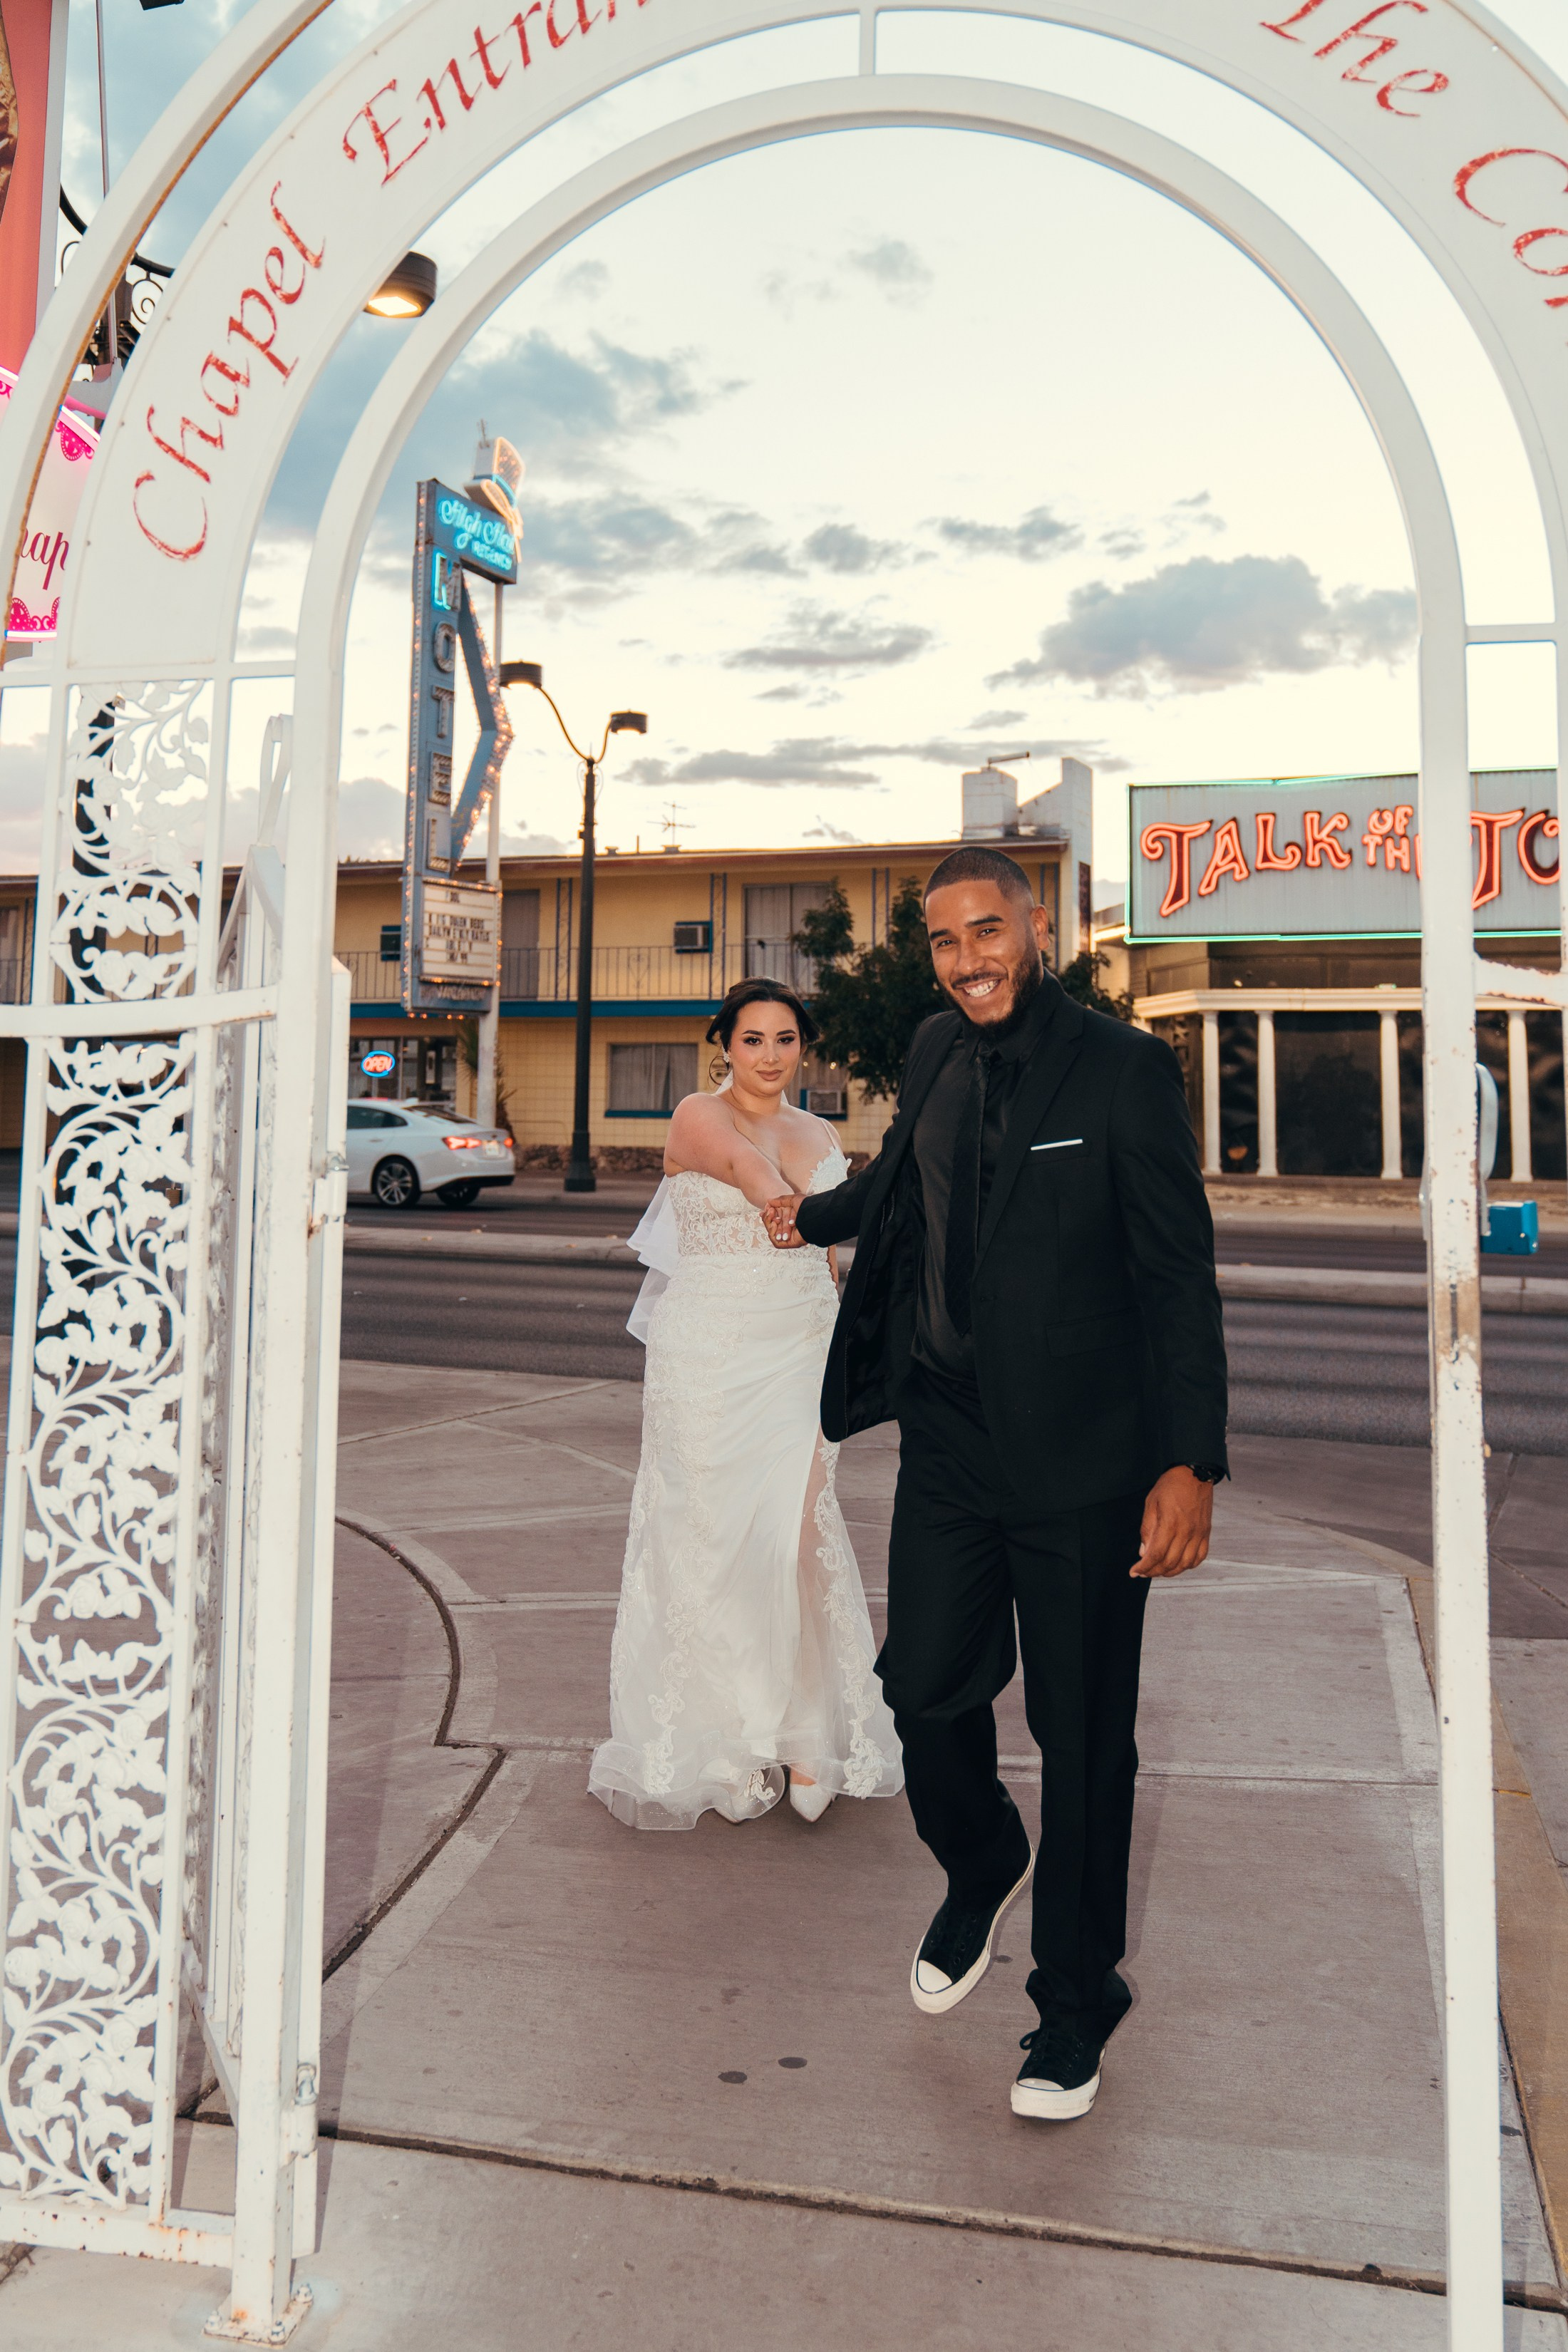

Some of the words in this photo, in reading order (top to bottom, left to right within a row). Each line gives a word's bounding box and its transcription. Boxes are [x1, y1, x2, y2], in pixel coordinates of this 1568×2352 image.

[133, 180, 326, 562] Chapel
[343, 0, 651, 187] Entra
[439, 500, 483, 550] High
[428, 551, 463, 872] MOTEL
[1140, 811, 1351, 917] TALK
[1368, 805, 1414, 836] OF
[363, 1056, 393, 1073] OPEN
